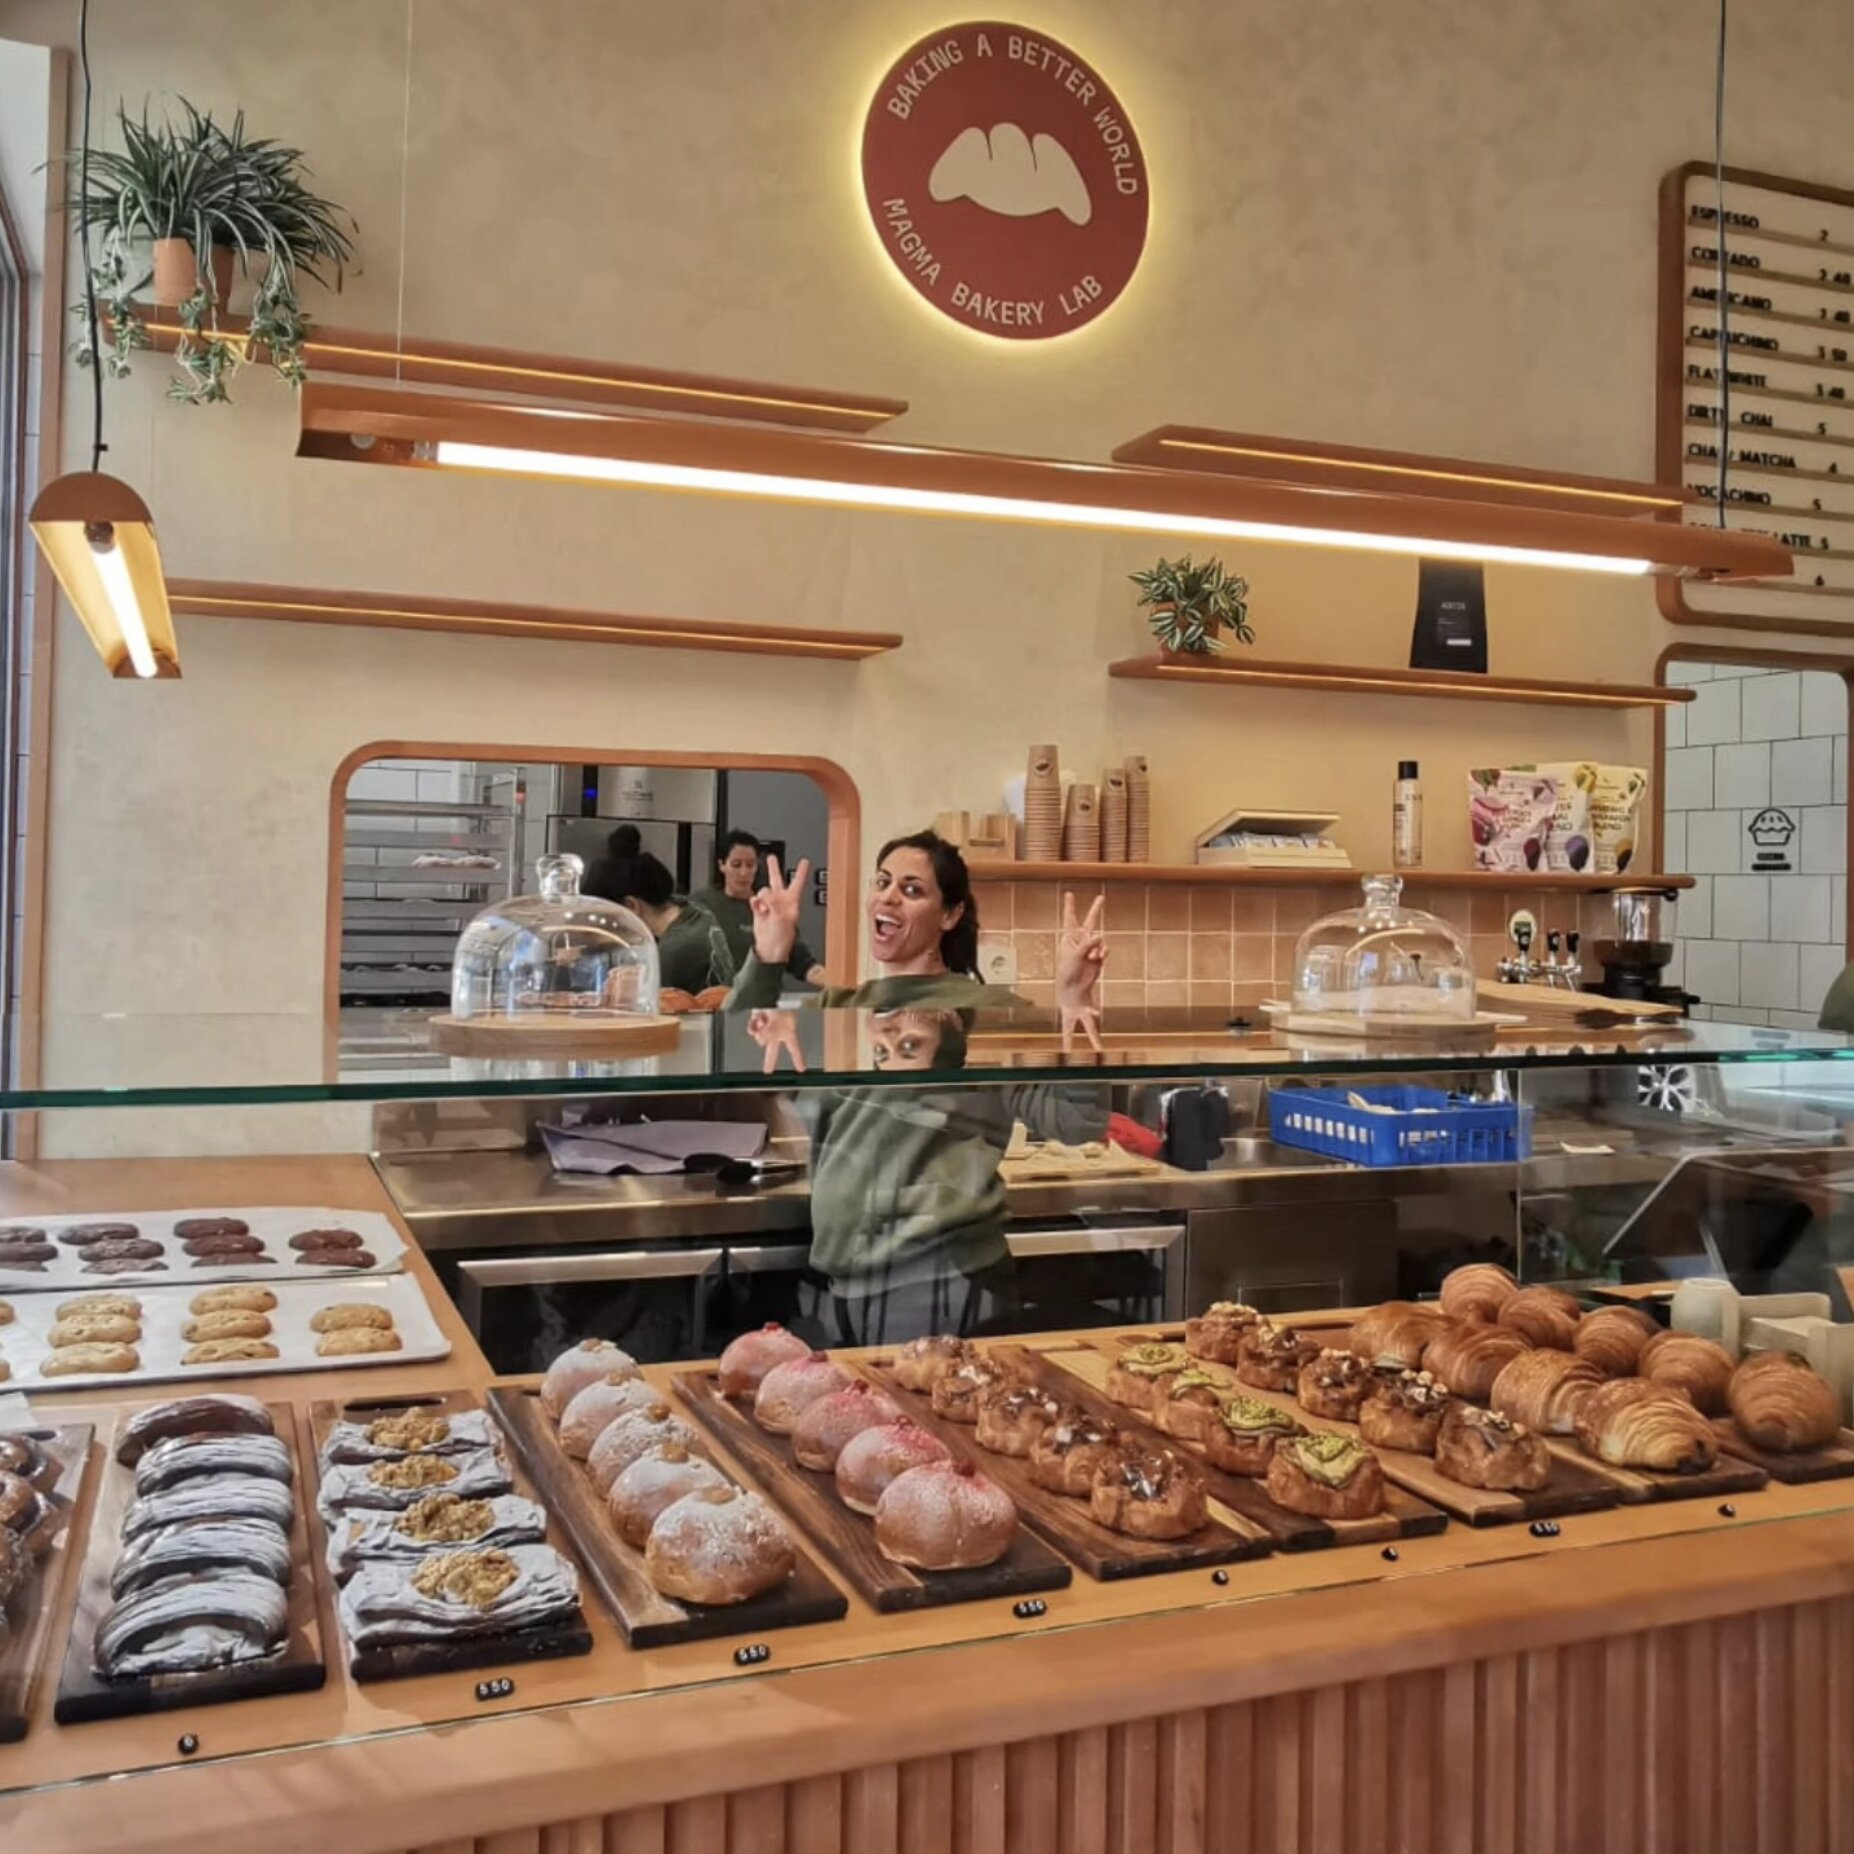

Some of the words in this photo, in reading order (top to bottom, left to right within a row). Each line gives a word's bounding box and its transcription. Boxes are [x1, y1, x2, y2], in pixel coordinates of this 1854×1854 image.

[887, 40, 964, 120] BAKING
[976, 33, 993, 57] A
[1008, 35, 1096, 106] BETTER
[1093, 106, 1138, 195] WORLD
[883, 198, 942, 285] MAGMA
[951, 281, 1045, 326] BAKERY
[1059, 275, 1102, 316] LAB
[1740, 411, 1773, 428] CHAI
[1739, 449, 1797, 469] MATCHA
